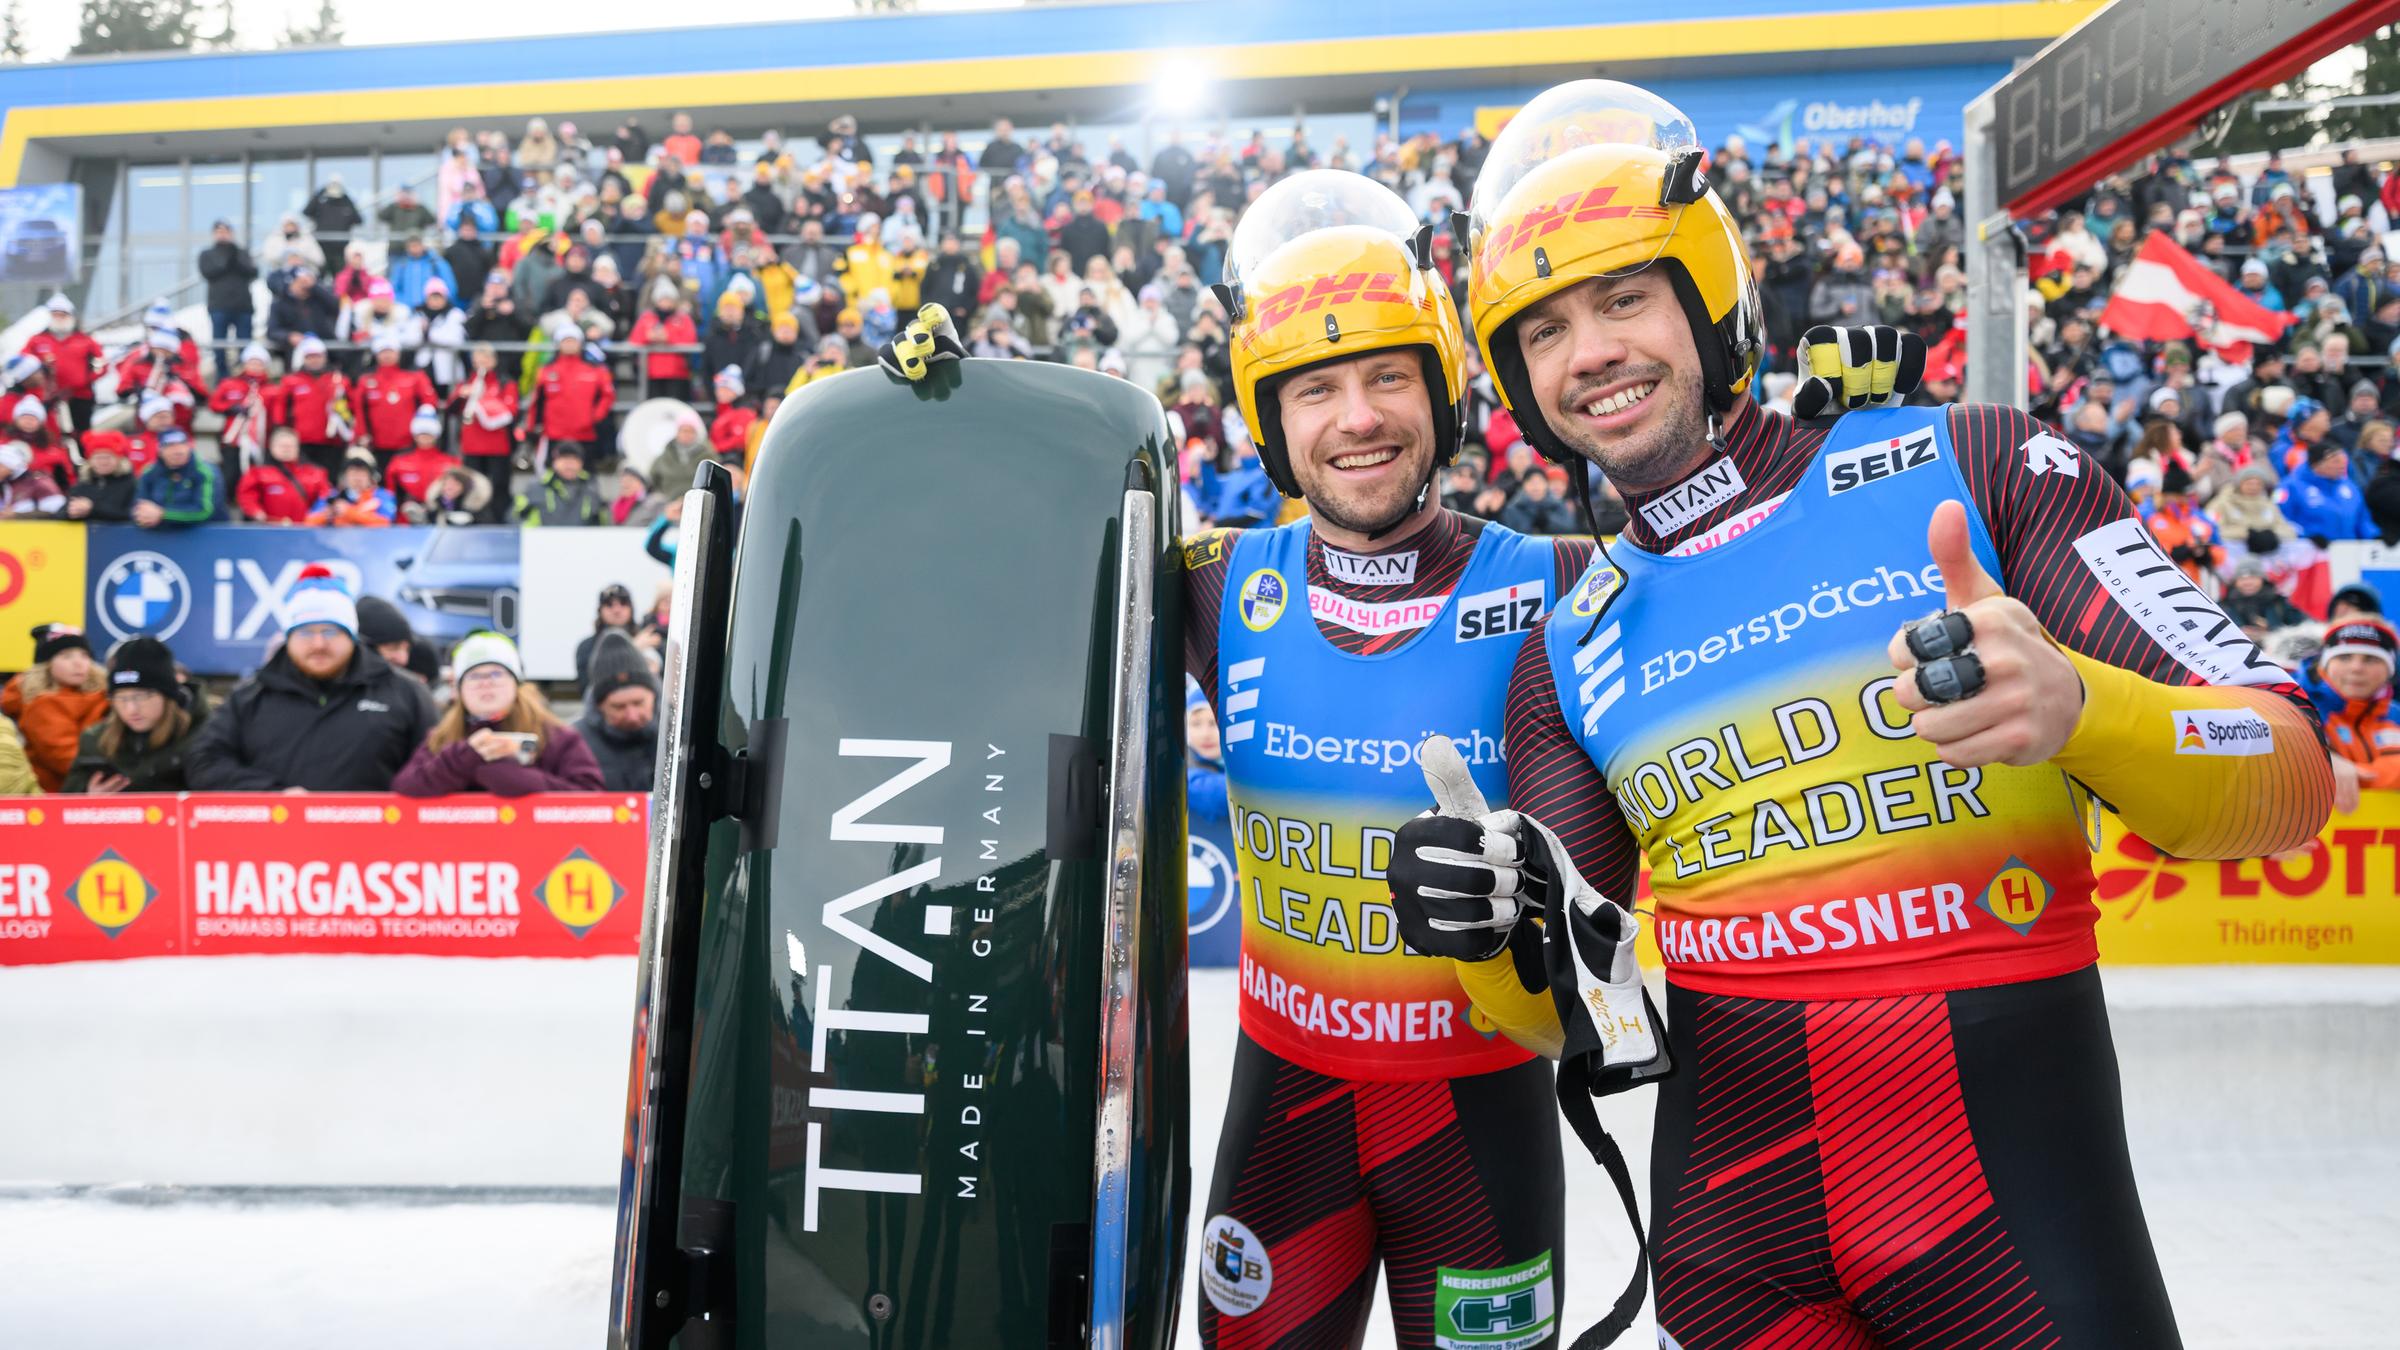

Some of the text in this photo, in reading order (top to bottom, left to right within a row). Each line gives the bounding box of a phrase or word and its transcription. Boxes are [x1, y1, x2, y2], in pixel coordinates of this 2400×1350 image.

[1803, 97, 1922, 131] Oberhof
[1484, 187, 1634, 273] DHL
[1256, 273, 1406, 334] DHL
[1832, 437, 1936, 491] SEIZ
[1309, 592, 1441, 629] BULLYLAND
[1459, 586, 1542, 639] SEIZ
[2094, 557, 2231, 681] MADE IN GERMANY
[2116, 527, 2286, 670] TITAN
[1264, 722, 1507, 774] Eberspch
[1616, 697, 1840, 836] WORLD
[1666, 760, 1991, 879] LEADER
[195, 861, 520, 915] HARGASSNER
[1253, 877, 1422, 956] LEAD
[1661, 882, 1971, 963] HARGASSNER
[196, 918, 520, 938] BIOMASS HEATING TECHNOLOGY
[2218, 919, 2353, 951] Thüringen
[803, 738, 952, 1232] TITAN
[957, 743, 1006, 1198] MADE IN GERMANY
[1243, 953, 1454, 1043] HARGASSNER
[1442, 1258, 1550, 1290] HERRENKNECHT
